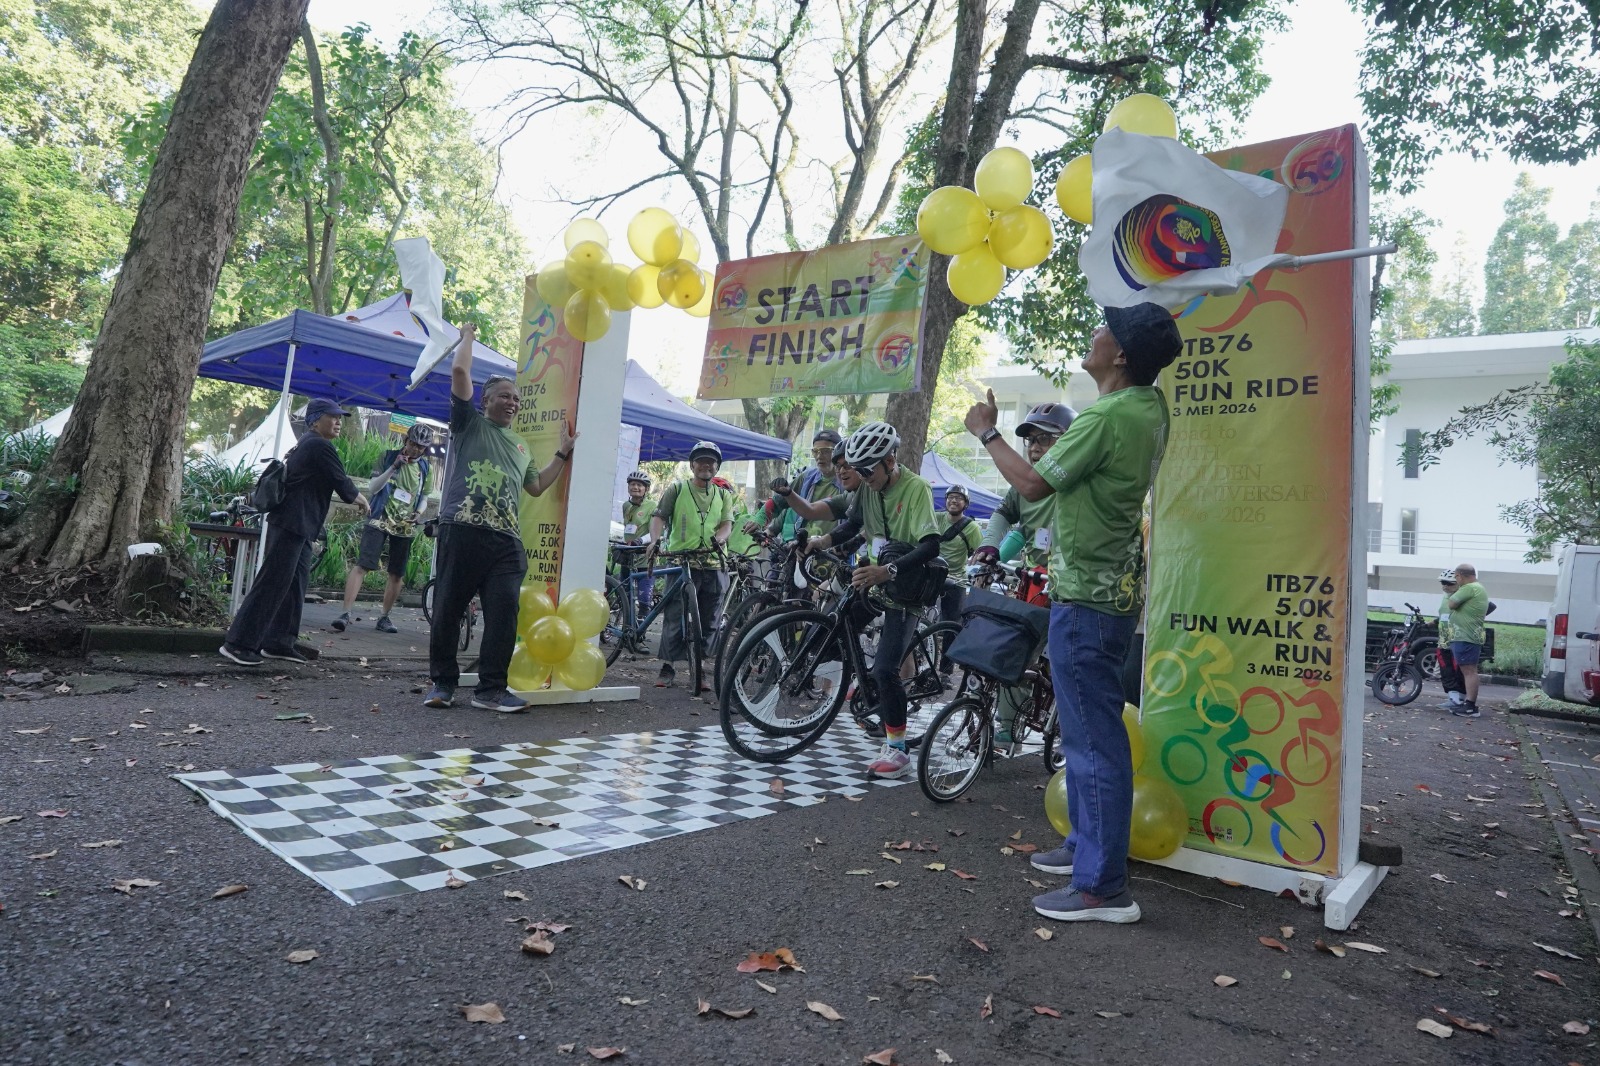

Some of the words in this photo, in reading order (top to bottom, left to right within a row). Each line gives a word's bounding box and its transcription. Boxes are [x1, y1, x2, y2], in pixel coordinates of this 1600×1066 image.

[755, 276, 875, 325] START
[746, 323, 865, 366] FINISH
[1174, 358, 1230, 380] 50K
[1175, 382, 1232, 402] FUN
[1246, 375, 1318, 399] RIDE
[520, 398, 537, 411] 50K
[1172, 407, 1181, 417] 3
[1186, 405, 1213, 416] MEI
[1219, 403, 1256, 415] 2026
[517, 412, 537, 424] FUN
[541, 409, 567, 422] RIDE
[1168, 424, 1211, 441] road
[1219, 426, 1237, 440] to
[1168, 463, 1263, 481] GOLDEN
[538, 523, 561, 534] ITB76
[540, 537, 560, 547] 5.0K
[551, 551, 558, 560] &
[538, 562, 557, 574] RUN
[1266, 574, 1334, 595] ITB76
[1275, 597, 1334, 618] 5.0K
[1170, 612, 1217, 633] FUN
[1227, 617, 1304, 640] WALK
[1313, 623, 1333, 642] &
[1275, 643, 1332, 666] RUN
[1246, 663, 1255, 674] 3
[1260, 664, 1288, 677] MEI
[1293, 667, 1332, 682] 2026
